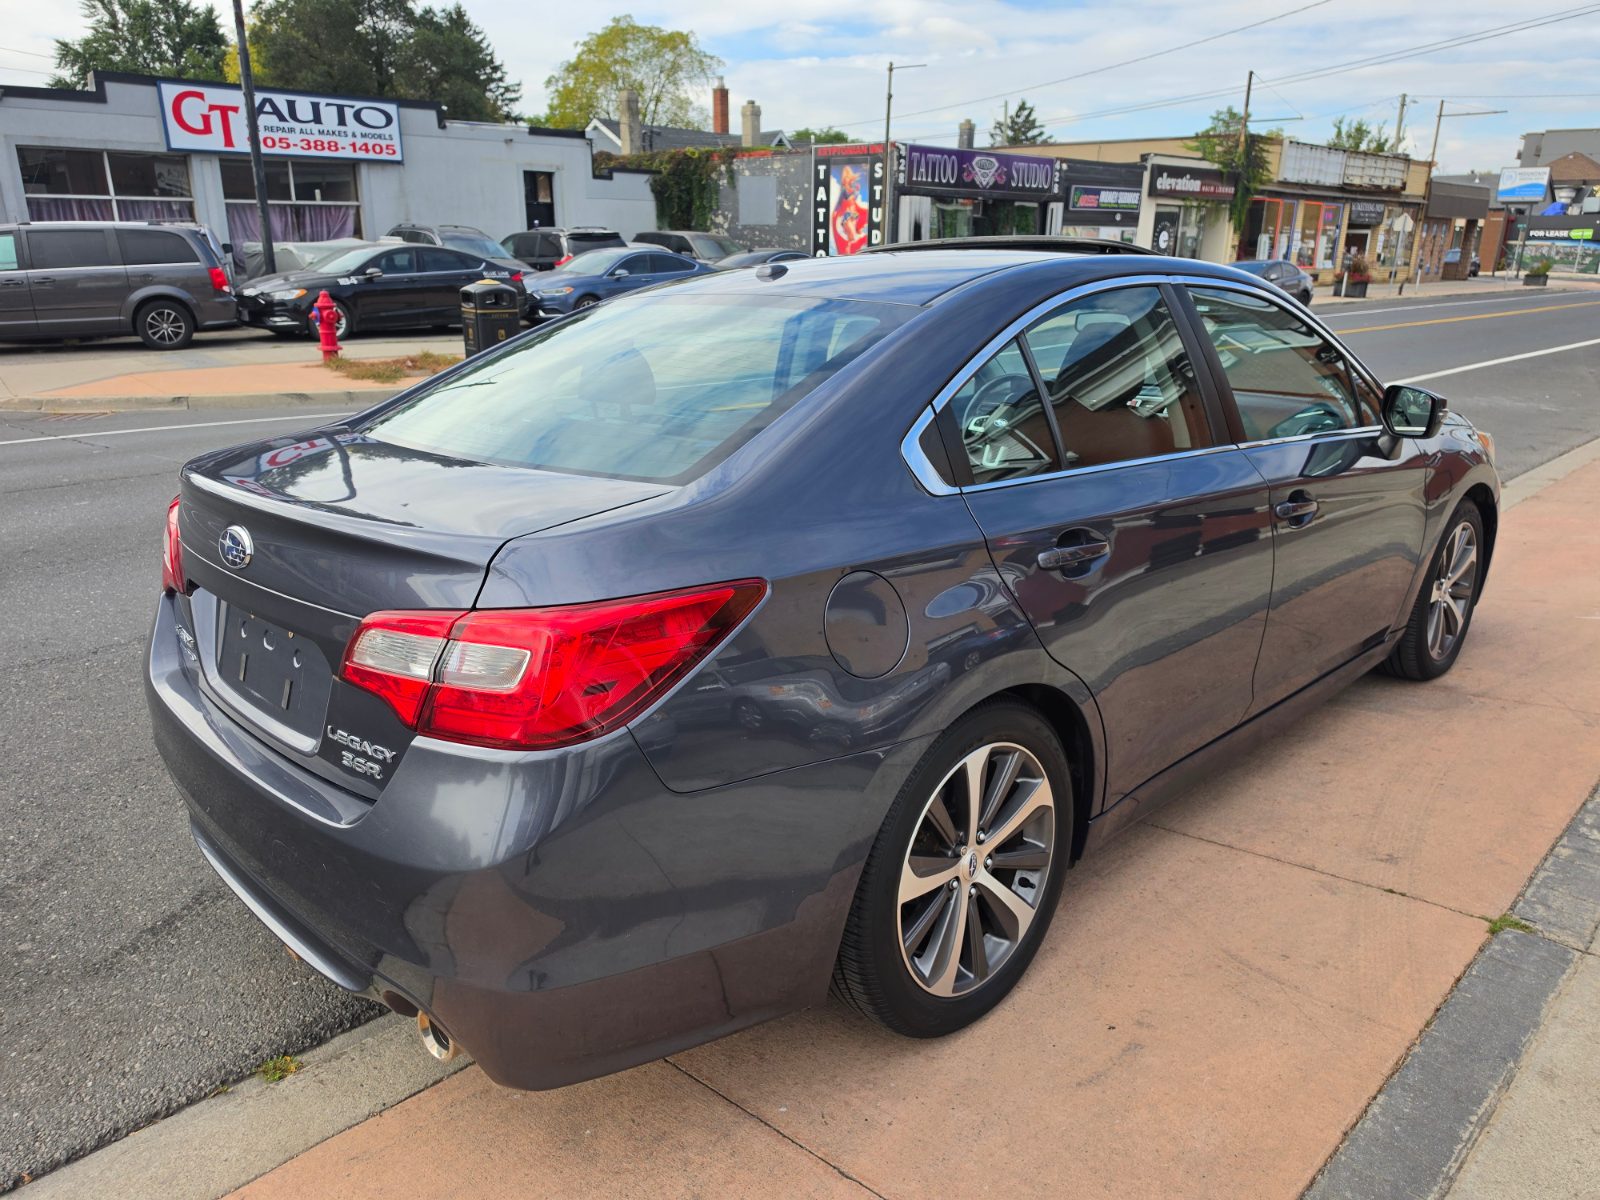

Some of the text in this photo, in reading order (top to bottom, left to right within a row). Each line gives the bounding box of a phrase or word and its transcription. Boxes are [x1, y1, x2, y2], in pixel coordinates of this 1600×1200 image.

[171, 90, 394, 148] GT AUTO
[263, 125, 297, 134] REPAIR
[300, 127, 315, 136] ALL
[318, 129, 349, 138] MAKES
[360, 132, 394, 141] MODELS
[247, 135, 397, 156] 05-388-1405
[911, 151, 1051, 189] TATTOO STUDIO
[1156, 171, 1202, 192] elevation
[1529, 230, 1545, 238] FOR
[1545, 230, 1569, 238] LEASE
[327, 725, 397, 763] LEGACY
